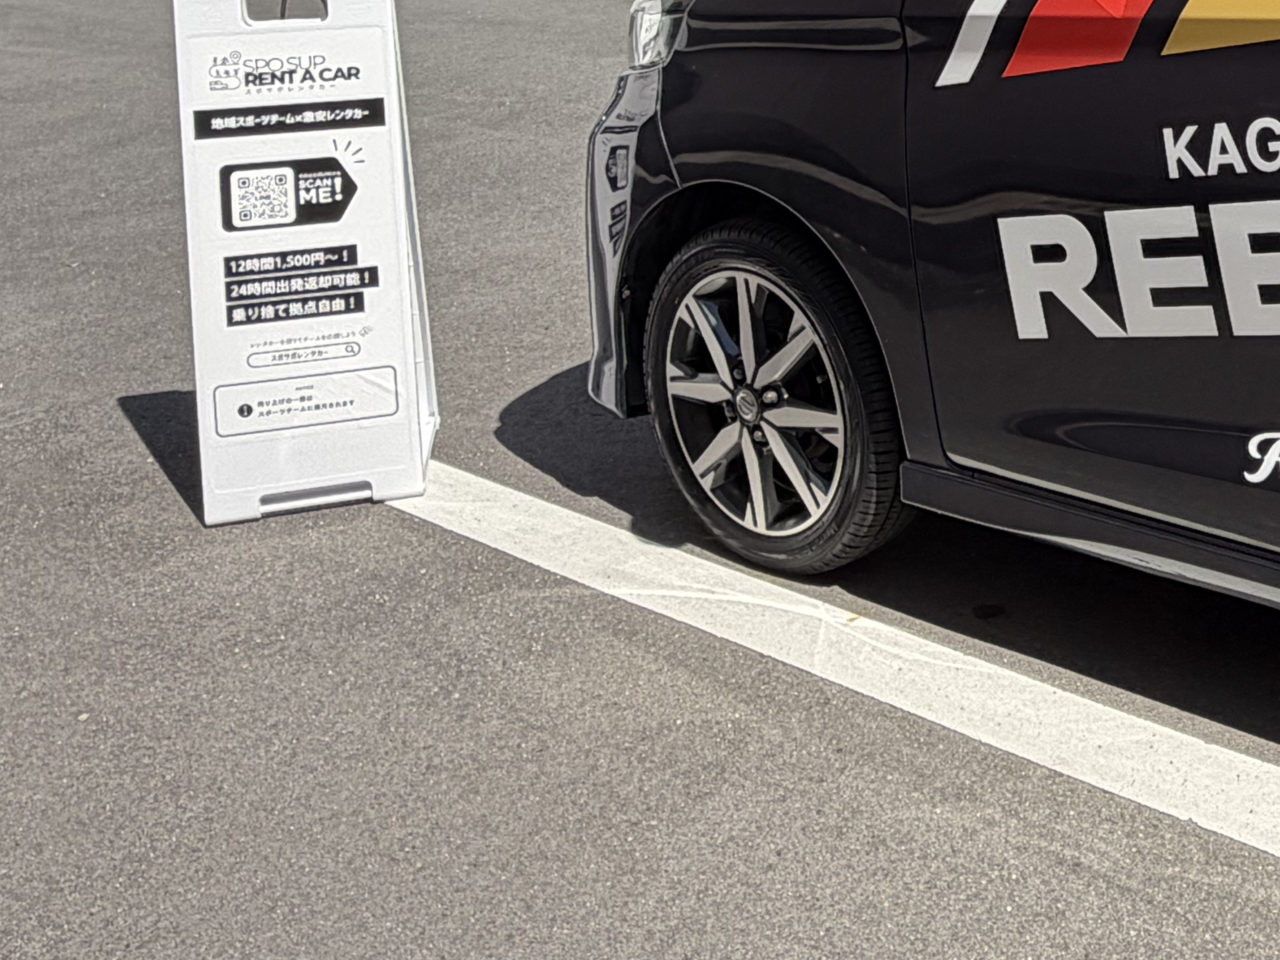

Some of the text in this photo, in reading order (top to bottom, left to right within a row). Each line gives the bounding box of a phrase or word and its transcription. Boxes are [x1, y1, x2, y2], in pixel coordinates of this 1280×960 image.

[244, 66, 361, 87] RENT A CAR
[298, 178, 332, 189] SCAN
